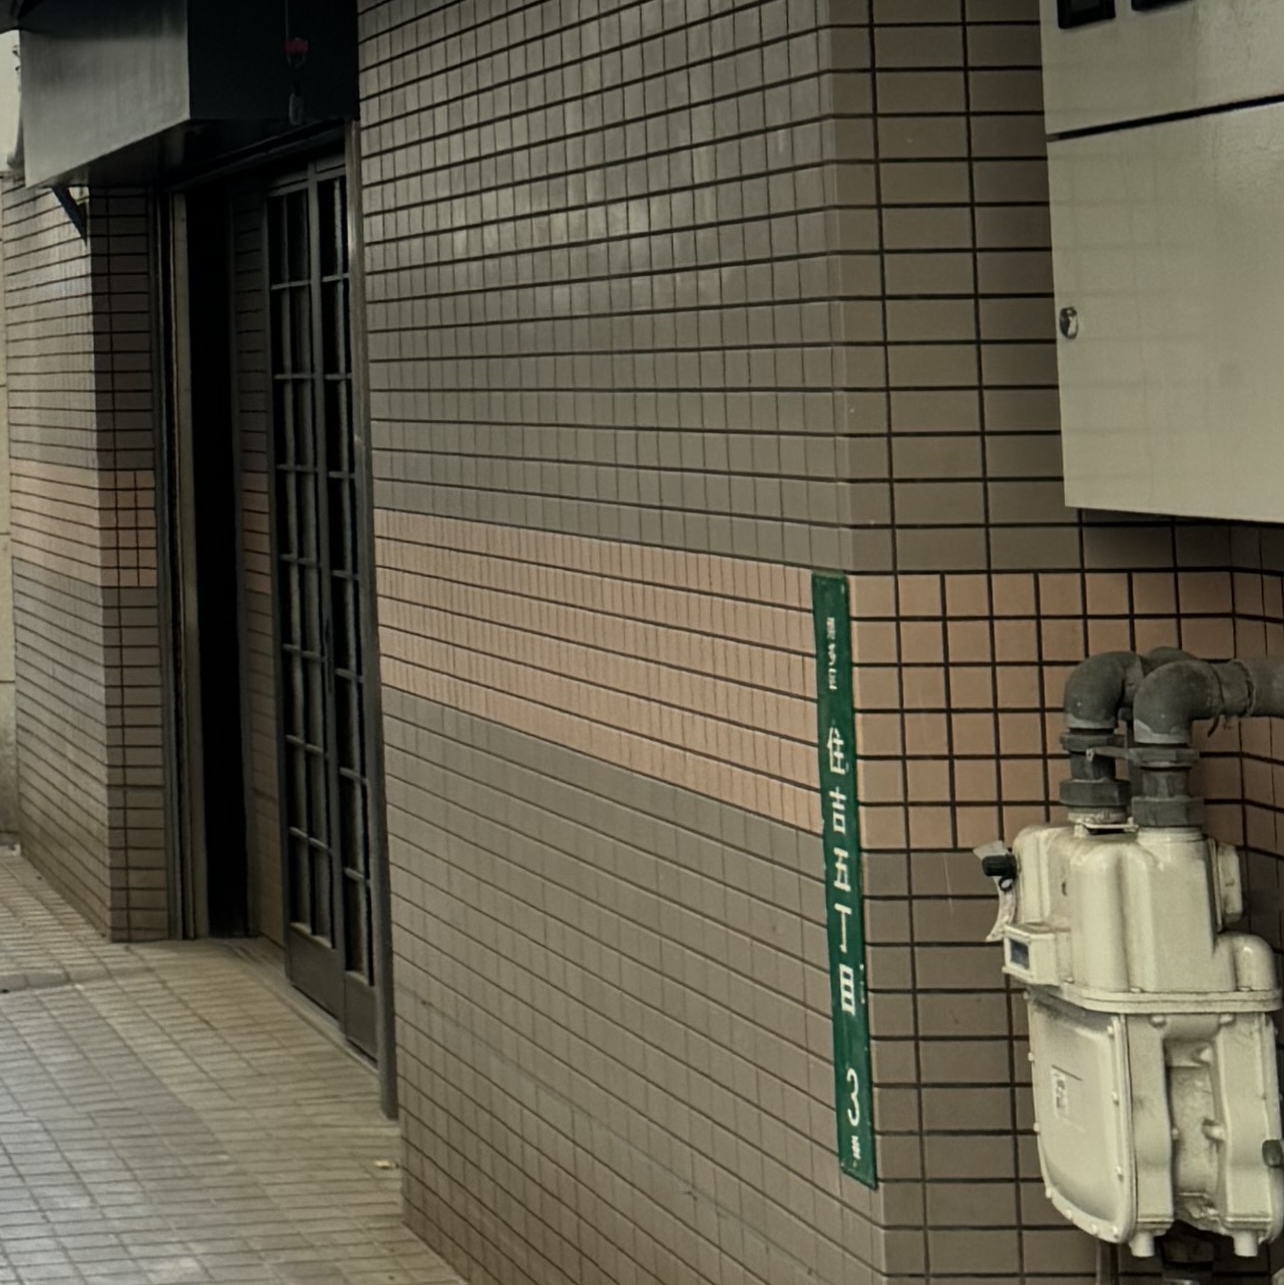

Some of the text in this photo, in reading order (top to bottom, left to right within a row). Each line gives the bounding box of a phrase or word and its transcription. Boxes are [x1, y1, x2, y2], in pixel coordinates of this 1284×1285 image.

[826, 726, 857, 1017] 住吉五丁目
